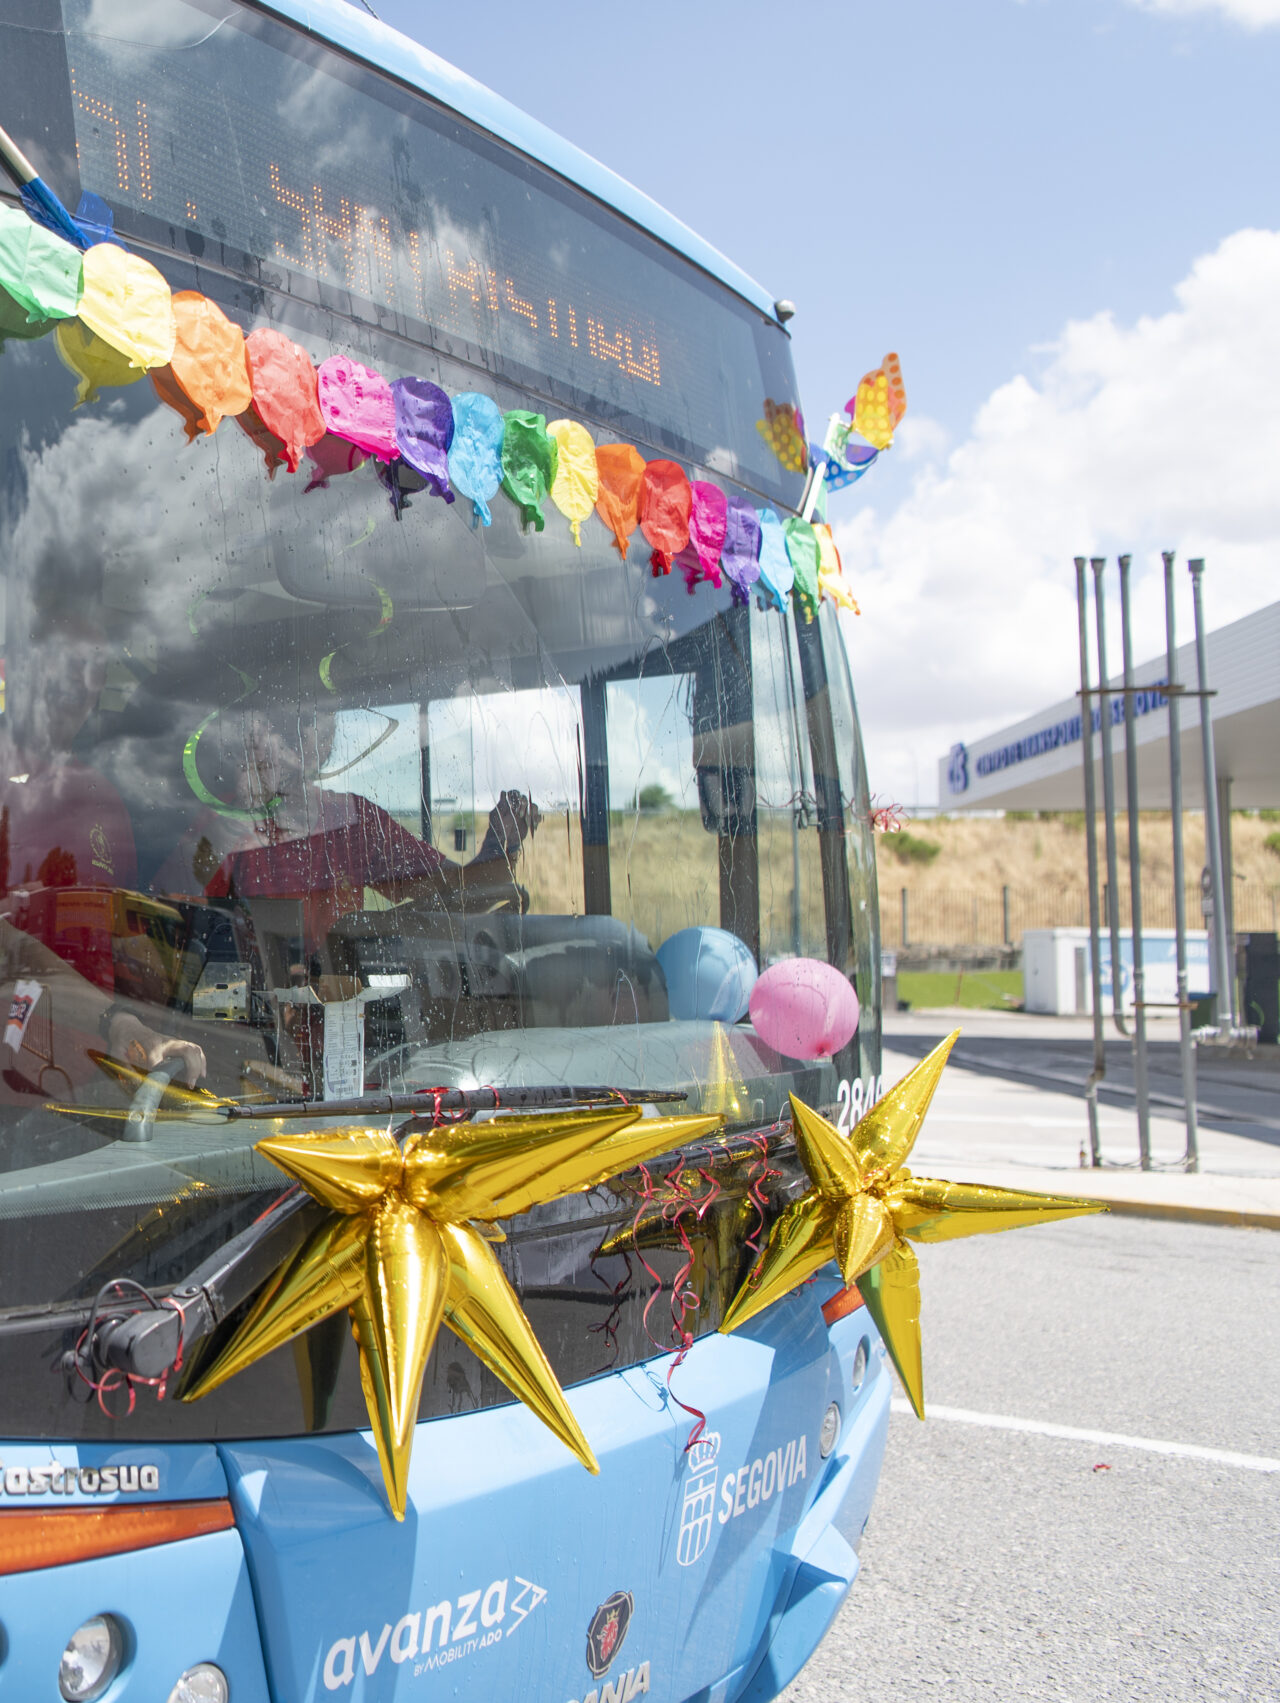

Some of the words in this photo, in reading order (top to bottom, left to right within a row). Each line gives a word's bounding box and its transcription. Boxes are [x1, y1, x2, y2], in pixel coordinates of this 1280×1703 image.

[718, 1434, 807, 1524] SEGOVIA
[323, 1578, 508, 1690] avanza
[424, 1638, 479, 1673] MOBILITY
[479, 1628, 503, 1649] ADO
